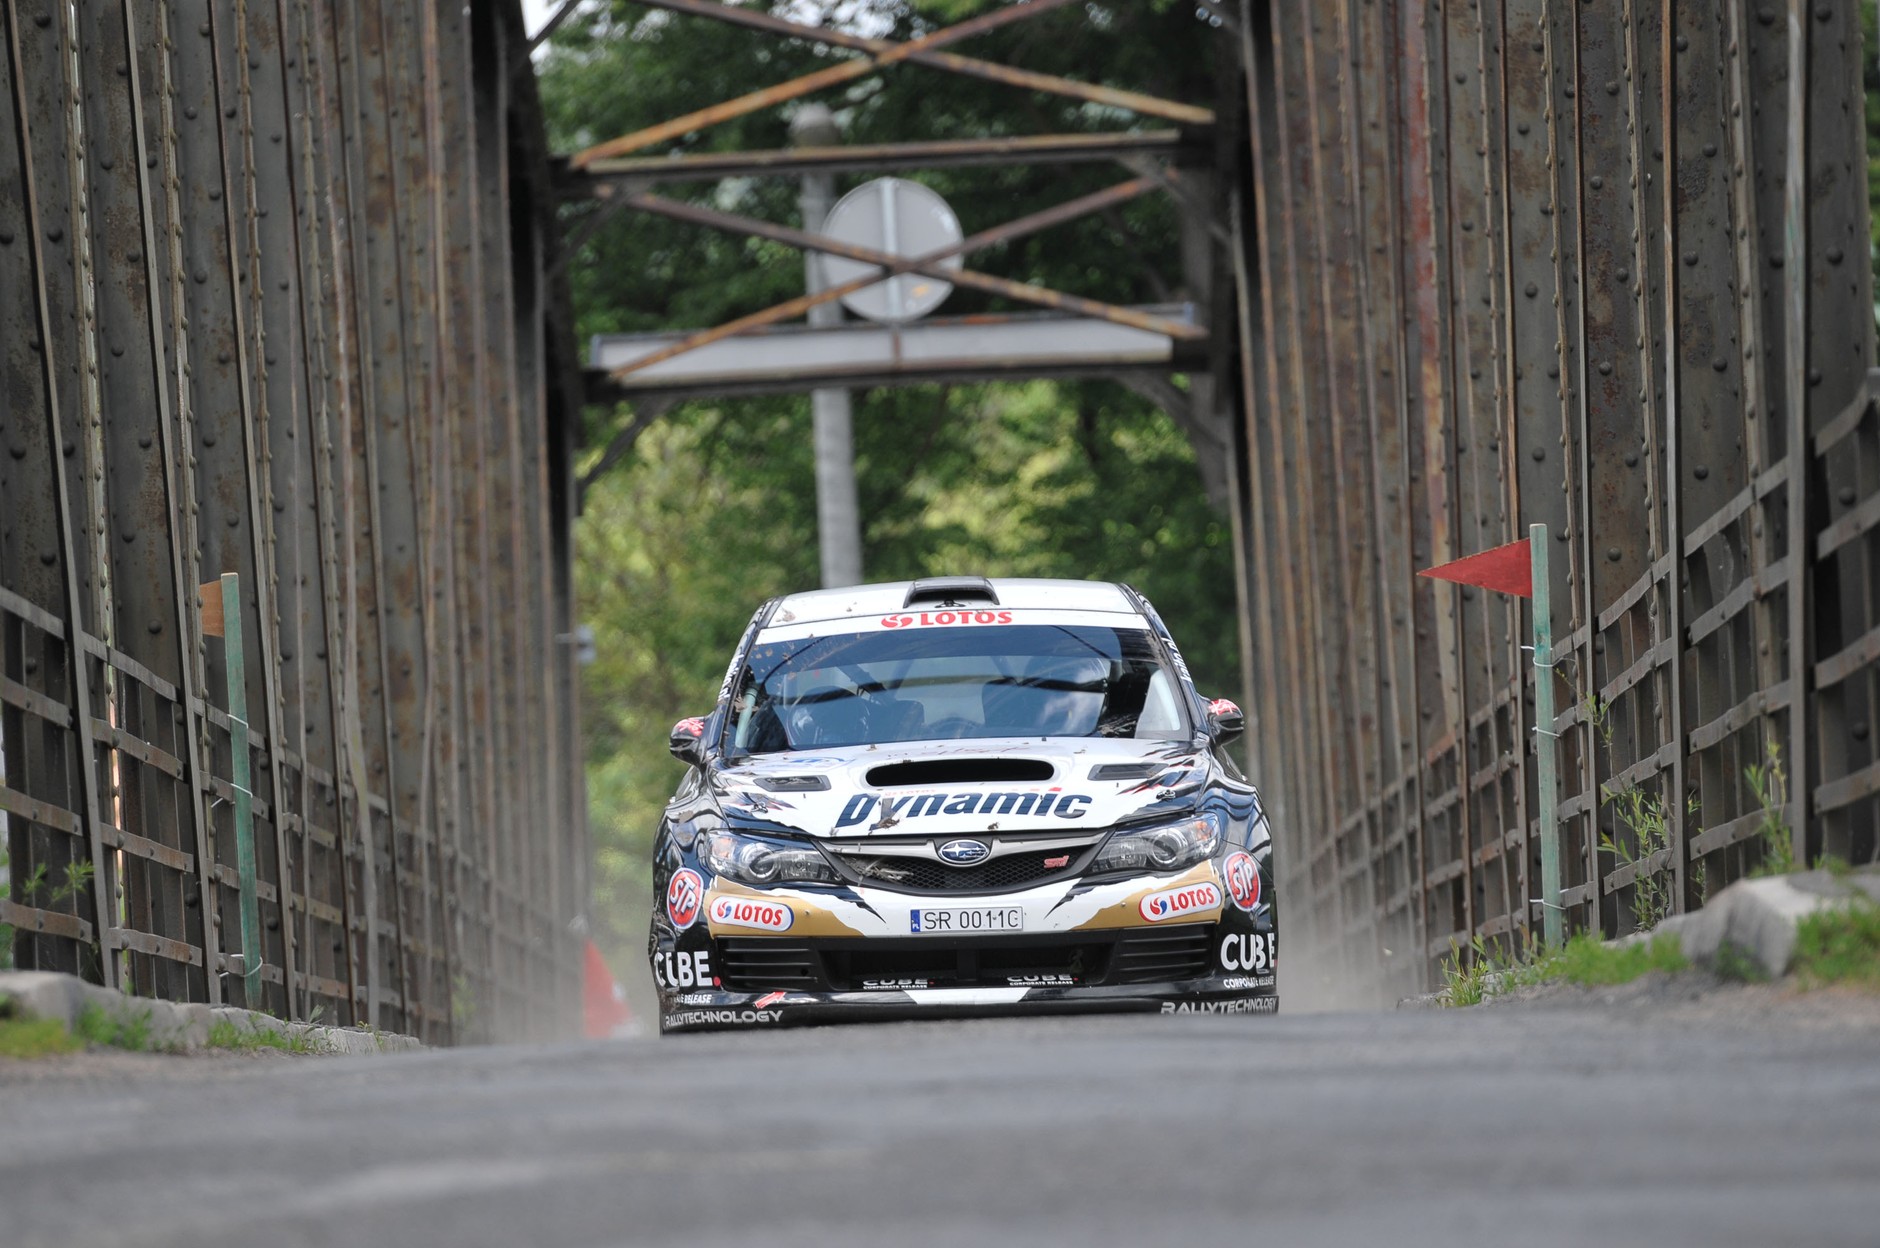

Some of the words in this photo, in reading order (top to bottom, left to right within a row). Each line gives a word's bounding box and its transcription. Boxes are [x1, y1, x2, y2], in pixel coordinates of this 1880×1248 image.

[920, 611, 1013, 626] LOTOS
[835, 787, 1093, 831] Dynamic
[1232, 859, 1254, 901] STP
[669, 876, 697, 914] STP
[1169, 887, 1215, 912] LOTOS
[733, 903, 783, 926] LOTOS
[924, 911, 951, 930] SR
[1160, 997, 1277, 1015] RALLYTECHNOLOGY
[664, 1010, 783, 1028] RALLYTECHNOLOGY
